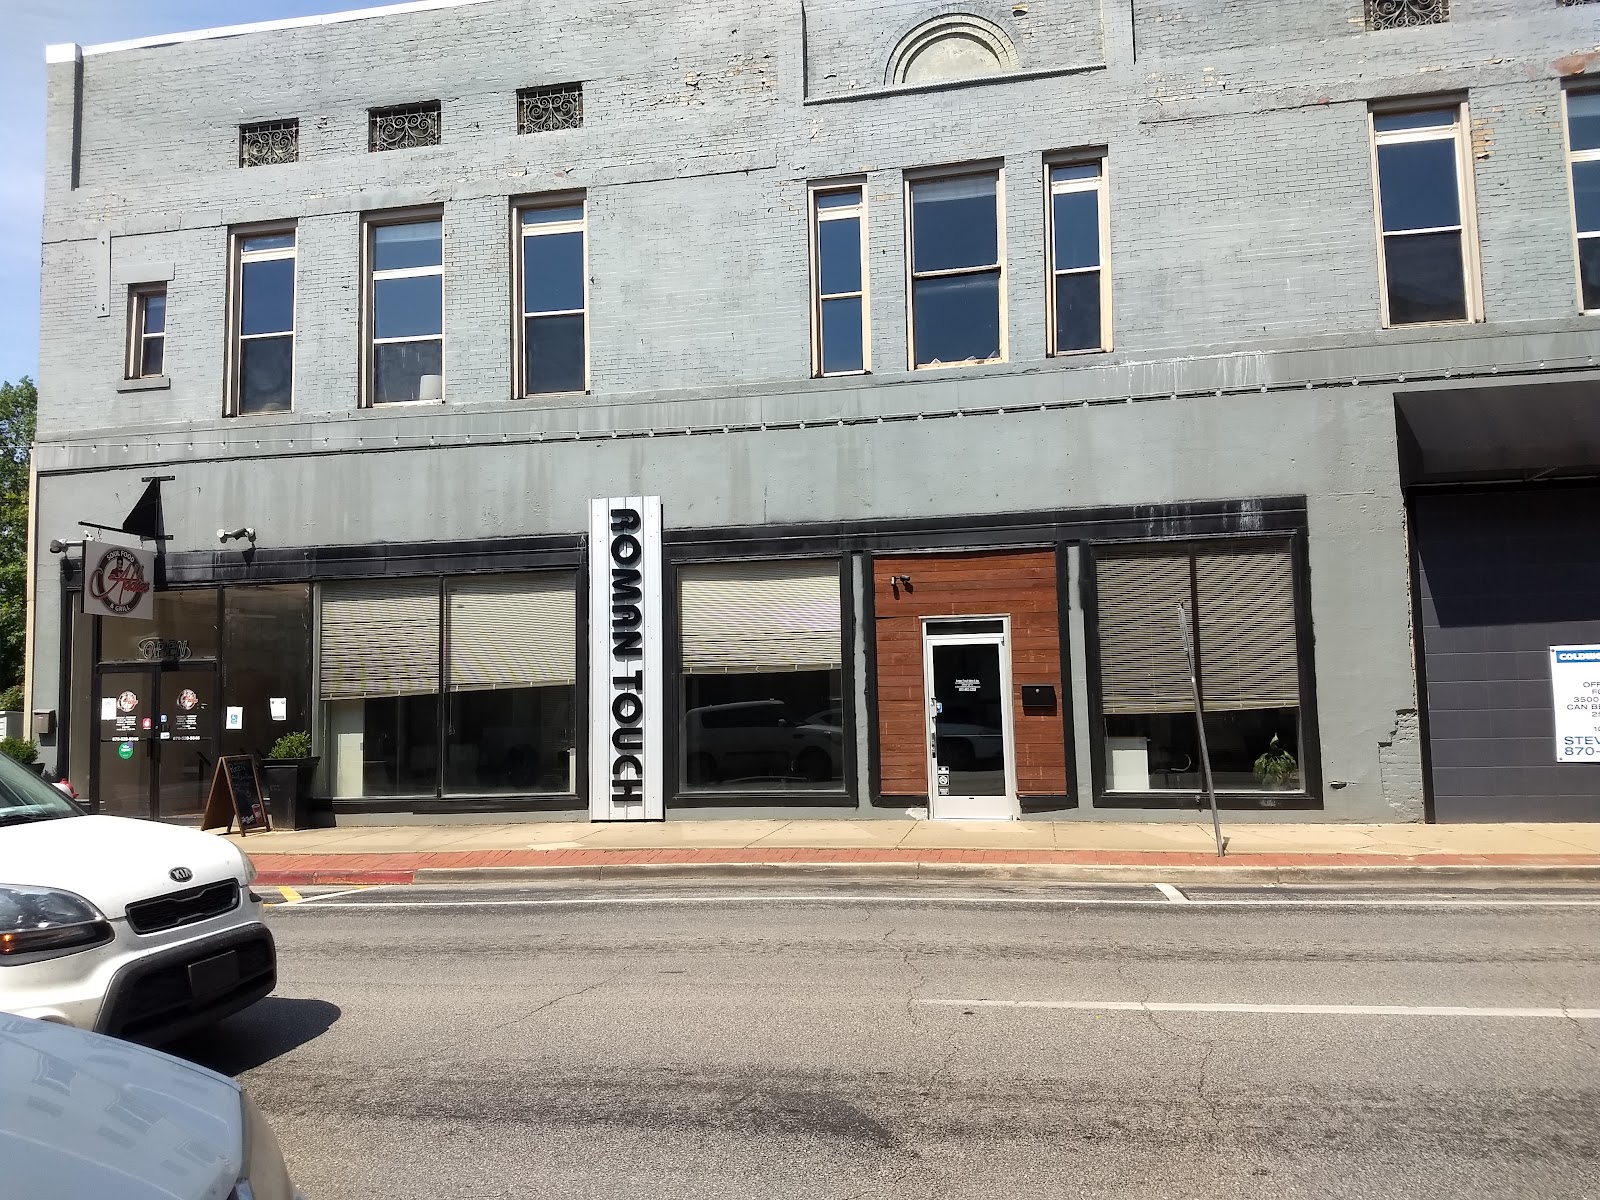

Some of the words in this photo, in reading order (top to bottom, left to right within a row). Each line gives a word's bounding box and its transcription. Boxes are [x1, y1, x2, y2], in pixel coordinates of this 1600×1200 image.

[106, 551, 120, 560] SOUL
[120, 551, 135, 562] FOOD
[610, 508, 643, 656] ROMAN
[143, 640, 188, 659] OPEN
[611, 669, 643, 802] TOUCH
[1564, 746, 1600, 756] 870-
[173, 868, 191, 880] KIA
